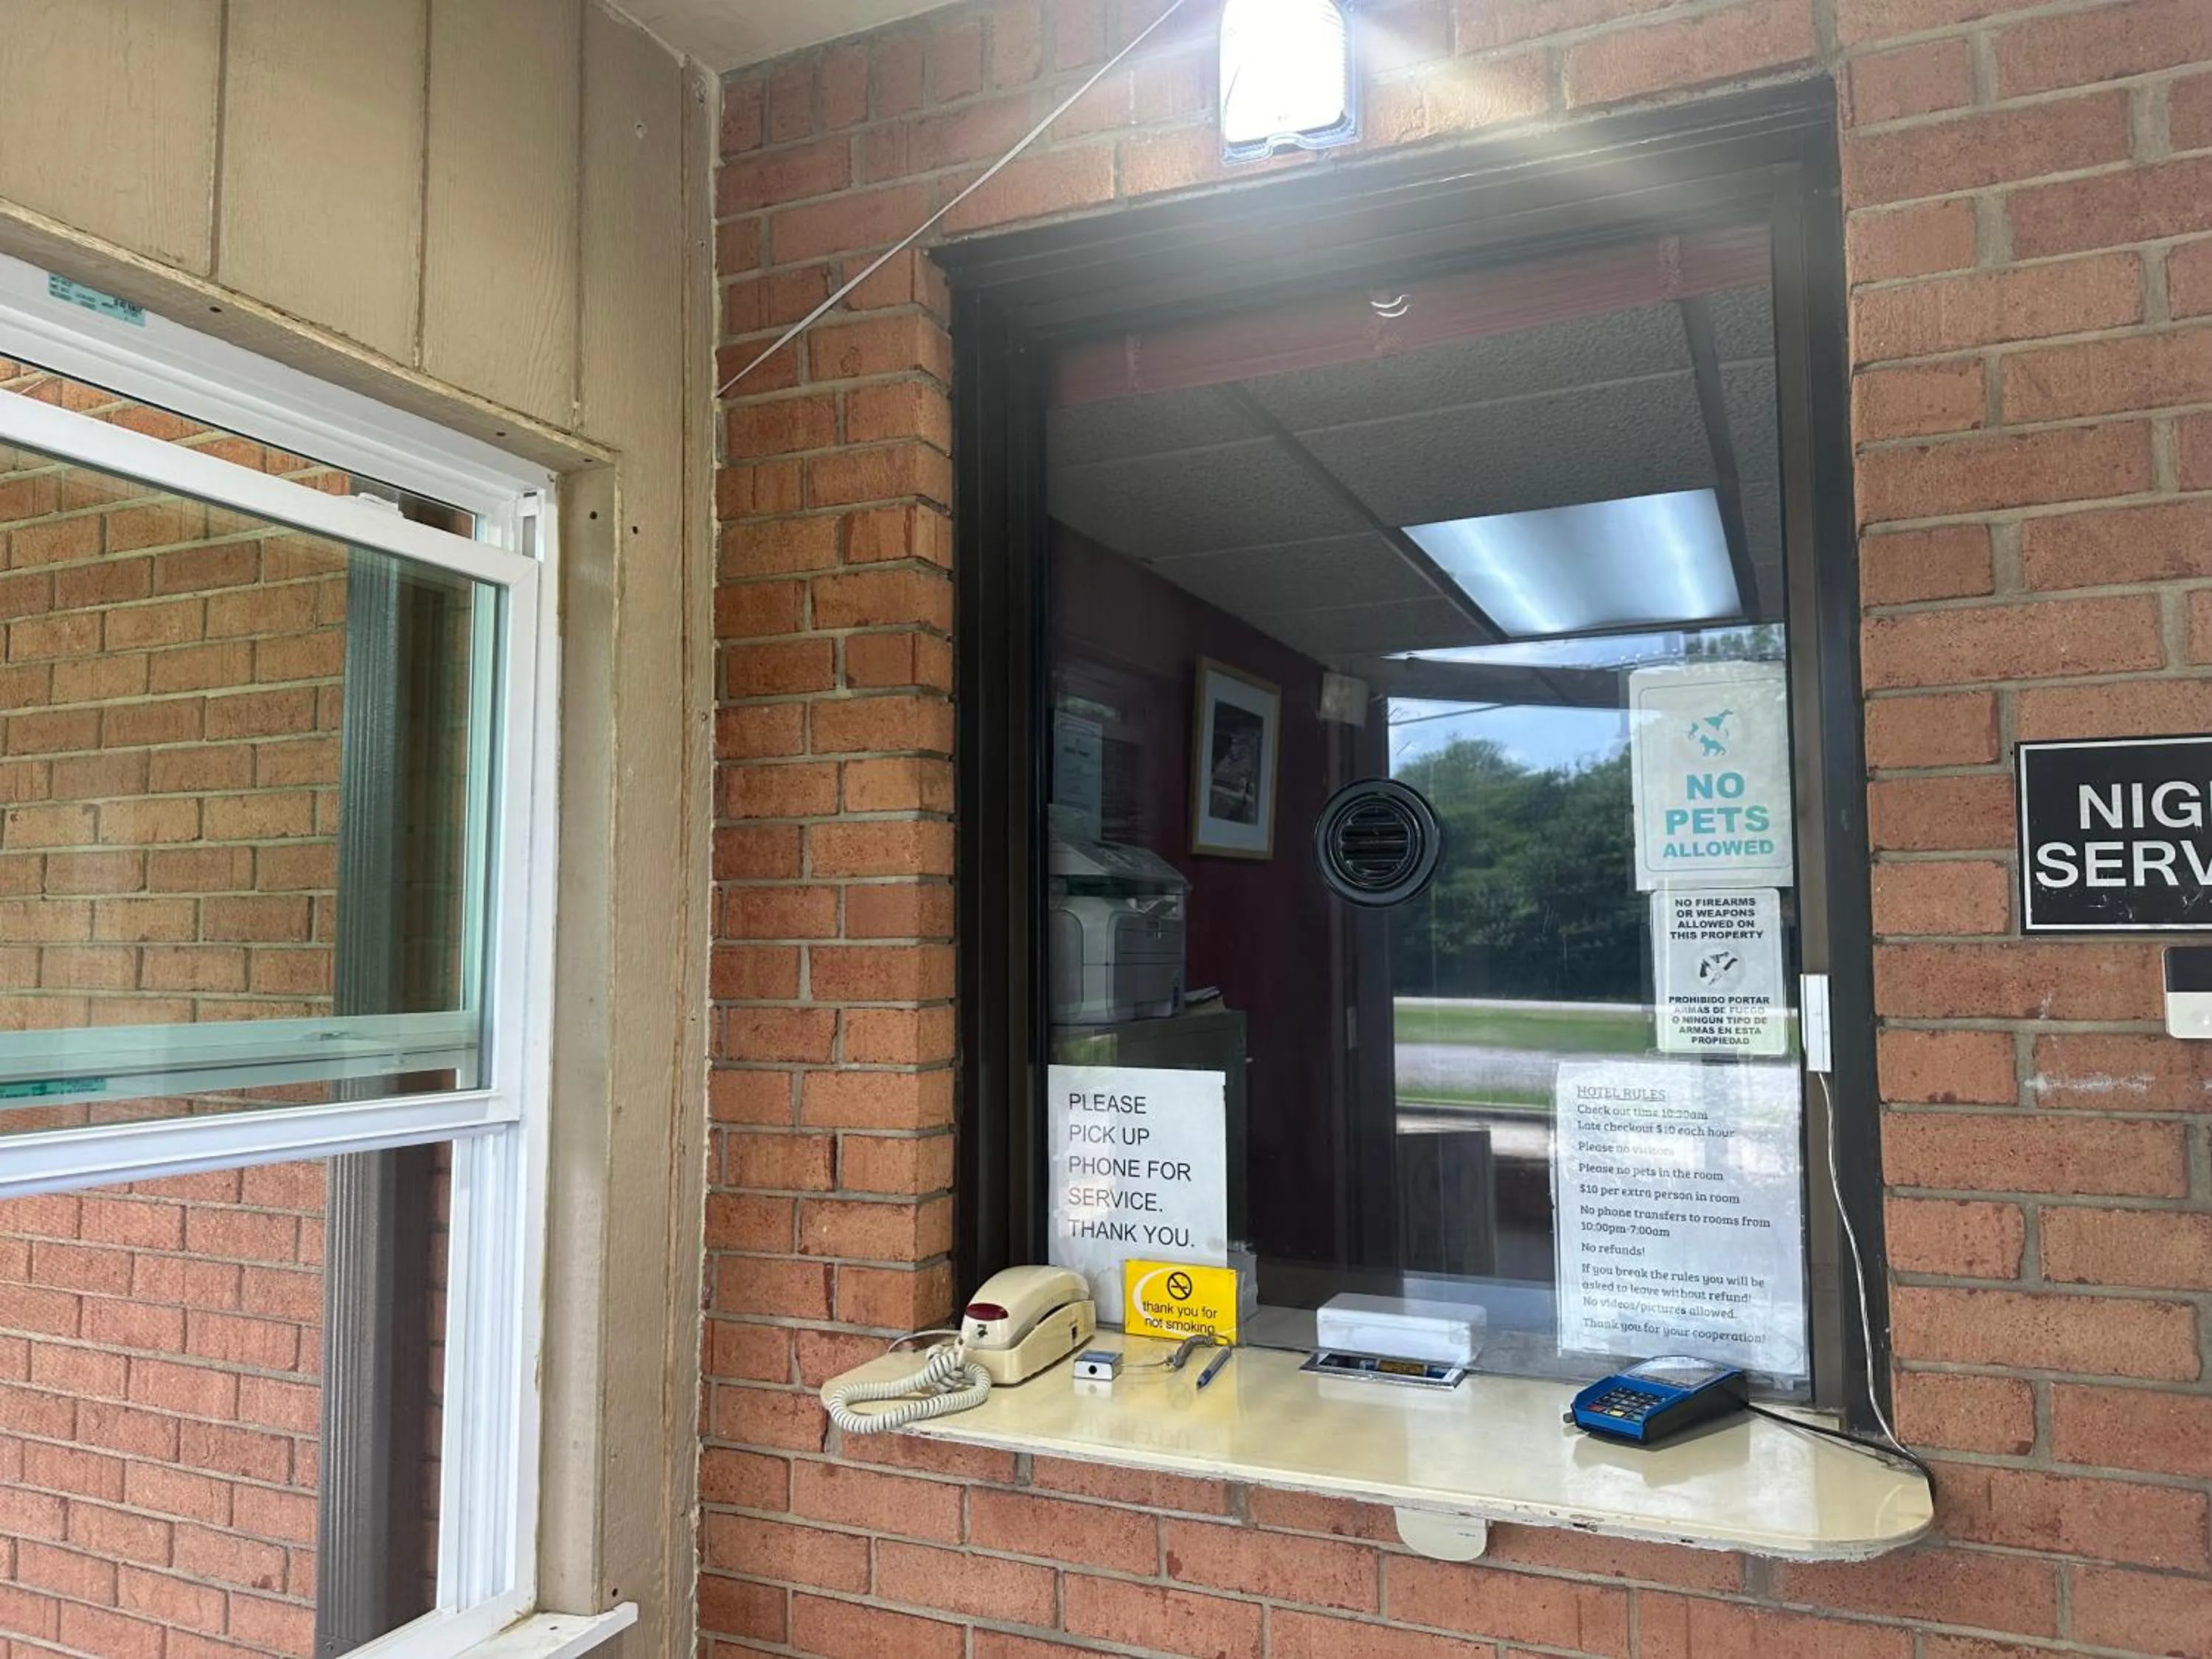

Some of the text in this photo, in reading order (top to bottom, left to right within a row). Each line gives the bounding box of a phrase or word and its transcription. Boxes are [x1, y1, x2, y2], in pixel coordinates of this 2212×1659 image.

[1686, 772, 1744, 800] NO
[2079, 780, 2212, 830] NIG
[1666, 805, 1770, 835] PETS
[1663, 840, 1774, 858] ALLOWED
[1675, 897, 1756, 907] NO FIREARMS
[1677, 909, 1755, 918] OR WEAPONS
[1677, 920, 1754, 928] ALLOWED ON
[1701, 930, 1764, 939] PROPERTY
[1728, 996, 1770, 1004] PORTAR
[1576, 1086, 1666, 1101] HOTEL RULES
[1068, 1093, 1147, 1114] PLEASE
[1577, 1104, 1610, 1115] Check
[1613, 1107, 1630, 1116] out
[1633, 1107, 1658, 1117] time
[1069, 1124, 1150, 1145] PICK UP
[1578, 1121, 1735, 1138] Late checkout $10 each hour
[1579, 1141, 1614, 1152] Please
[1616, 1145, 1630, 1153] no
[1068, 1156, 1192, 1181] PHONE FOR
[1579, 1163, 1614, 1174] Please
[1633, 1167, 1657, 1178] pets
[1659, 1168, 1670, 1177] in
[1672, 1168, 1691, 1178] the
[1694, 1171, 1723, 1180] room
[1068, 1187, 1164, 1213] SERVICE.
[1580, 1184, 1740, 1204] $10 per extra person in room
[1580, 1205, 1770, 1228] No phone transfers to rooms from
[1068, 1219, 1195, 1248] THANK YOU.
[1582, 1243, 1645, 1256] No refunds!
[1582, 1264, 1764, 1288] If you break the rules you will be
[1582, 1280, 1751, 1304] asked to leave without refund!
[1143, 1301, 1218, 1319] thank you for
[1583, 1297, 1598, 1307] No
[1600, 1297, 1686, 1315] videos/pictures
[1144, 1318, 1215, 1333] not smoking
[1584, 1318, 1766, 1343] Thank you for your cooperation!
